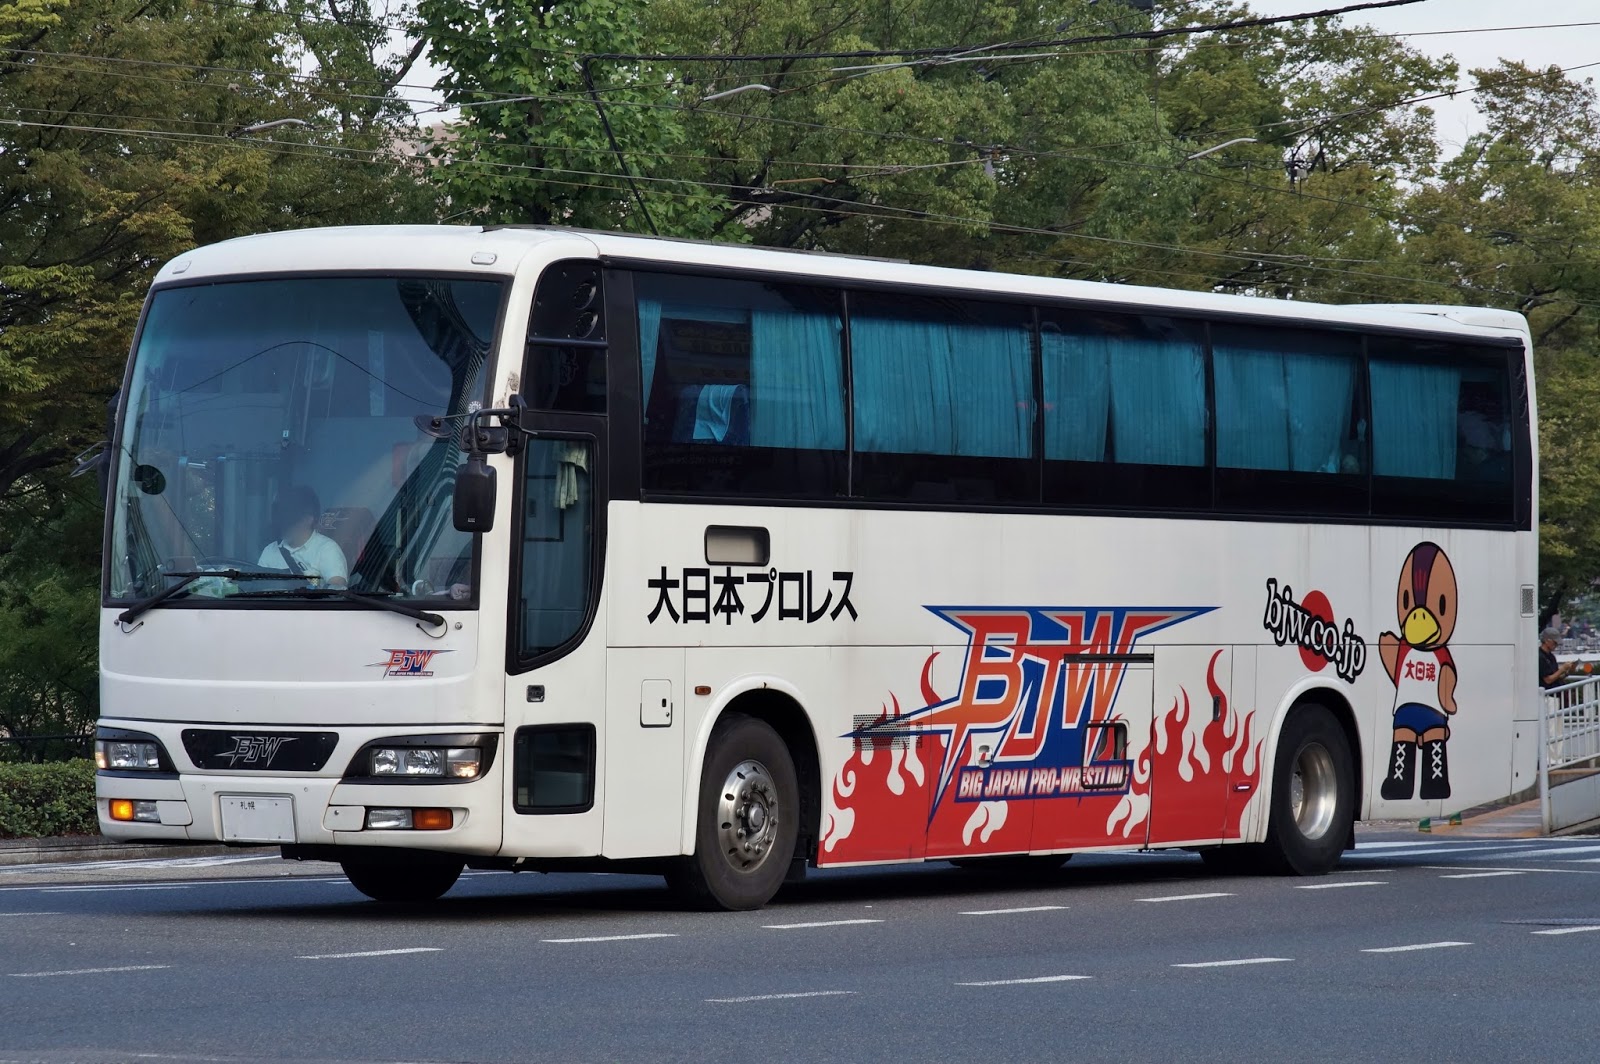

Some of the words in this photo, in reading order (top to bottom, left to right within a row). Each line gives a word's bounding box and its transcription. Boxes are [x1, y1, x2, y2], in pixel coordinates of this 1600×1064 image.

[647, 566, 859, 625] 大日本プロレス
[1263, 578, 1366, 684] bjw.co.jp
[370, 649, 455, 677] BJW
[880, 606, 1222, 800] BJW
[958, 770, 984, 798] BIG
[984, 768, 1029, 798] JAPAN
